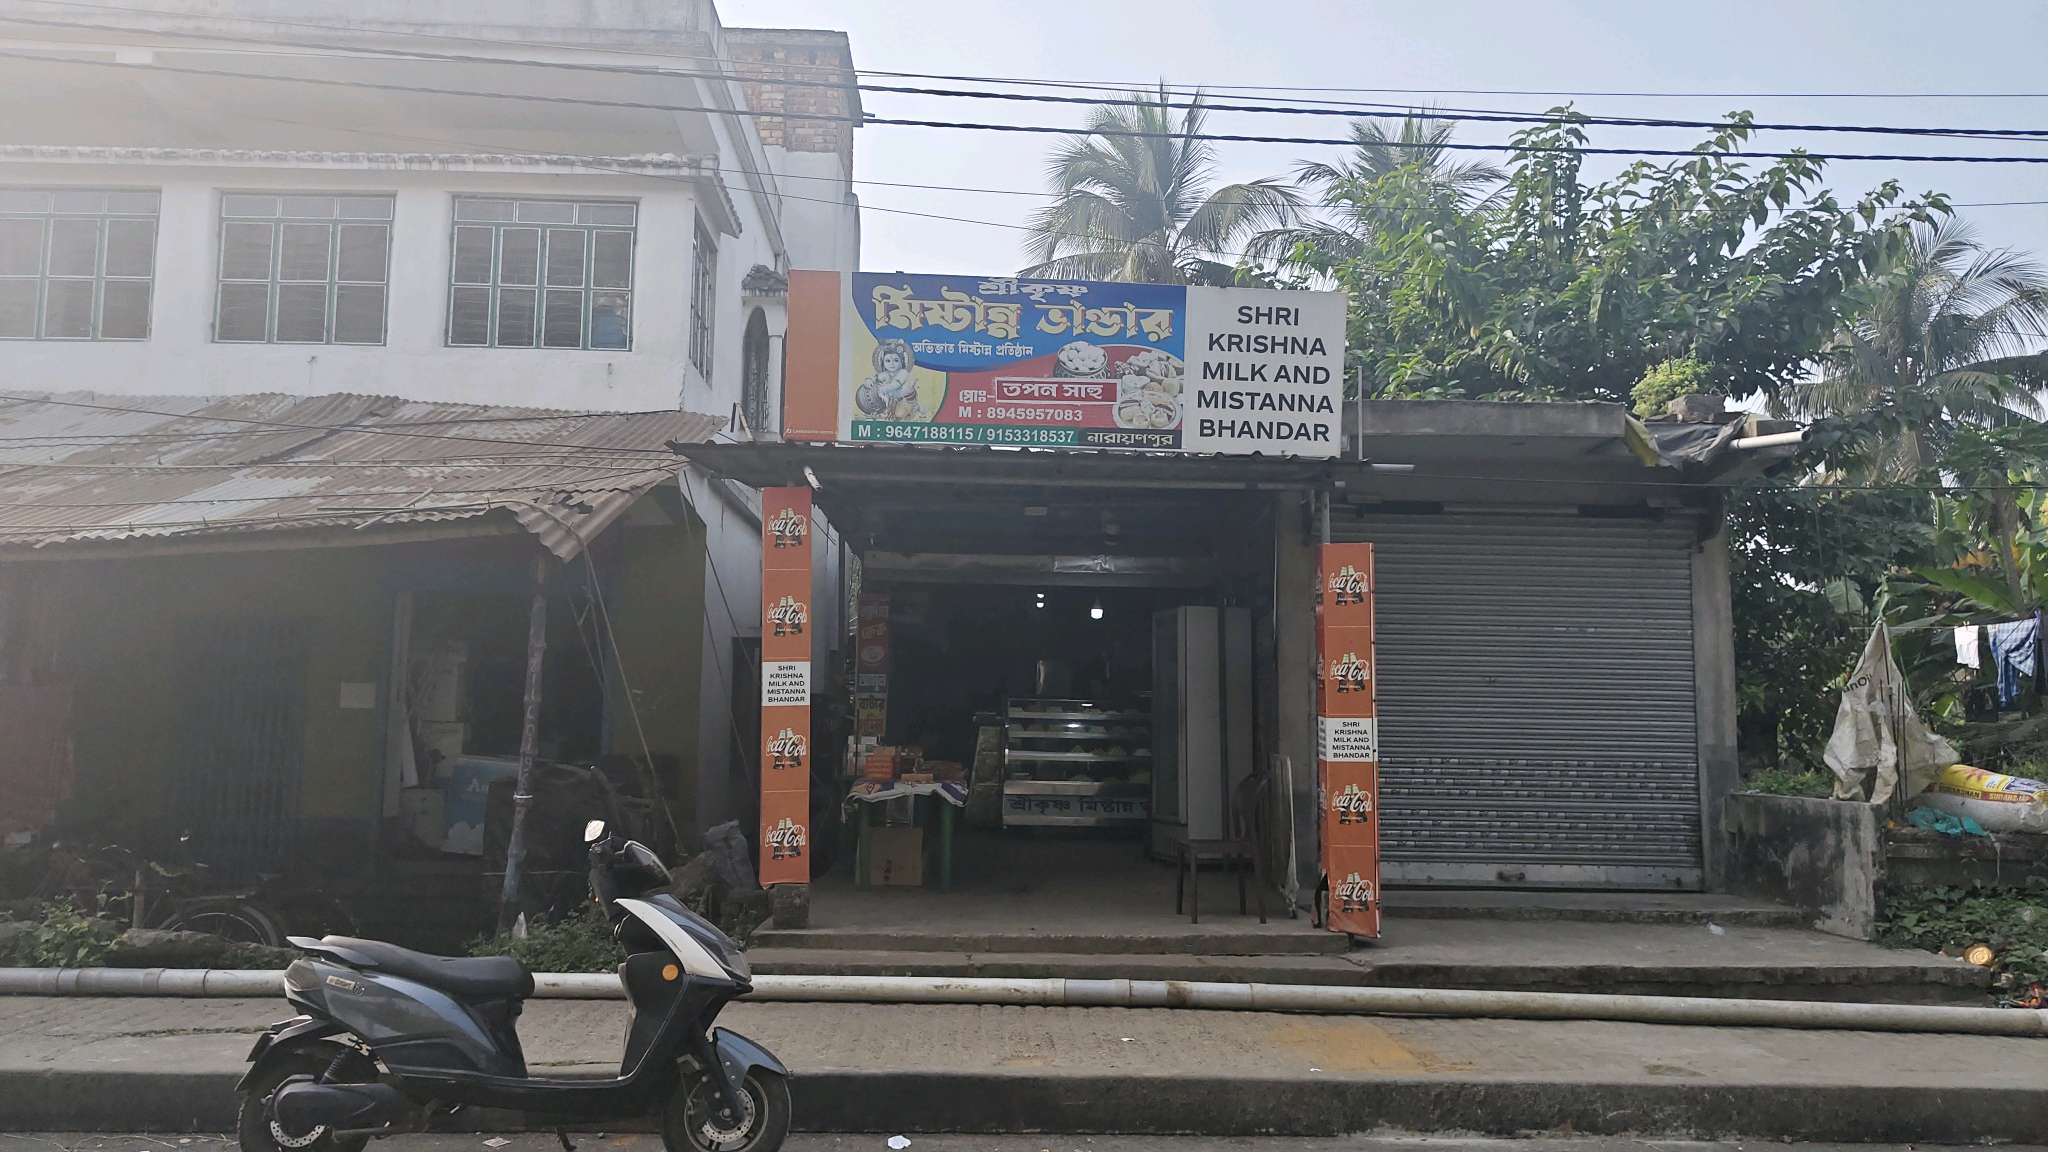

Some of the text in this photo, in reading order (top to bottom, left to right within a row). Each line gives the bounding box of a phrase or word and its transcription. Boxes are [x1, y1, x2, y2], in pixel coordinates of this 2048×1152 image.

[871, 284, 1022, 340] মিষ্টান্ন
[1237, 305, 1299, 326] SHRI
[1208, 333, 1327, 356] KRISHNA
[1202, 361, 1330, 385] MILK AND
[1002, 383, 1058, 398] তপন
[1063, 384, 1104, 400] সাহু
[1197, 390, 1334, 414] MISTANNA
[986, 407, 1083, 421] 8945957083
[885, 425, 973, 440] 9647188115
[986, 429, 1074, 442] 9153318537
[1087, 432, 1173, 447] নারায়ণপুর
[1199, 419, 1330, 442] BHANDAR
